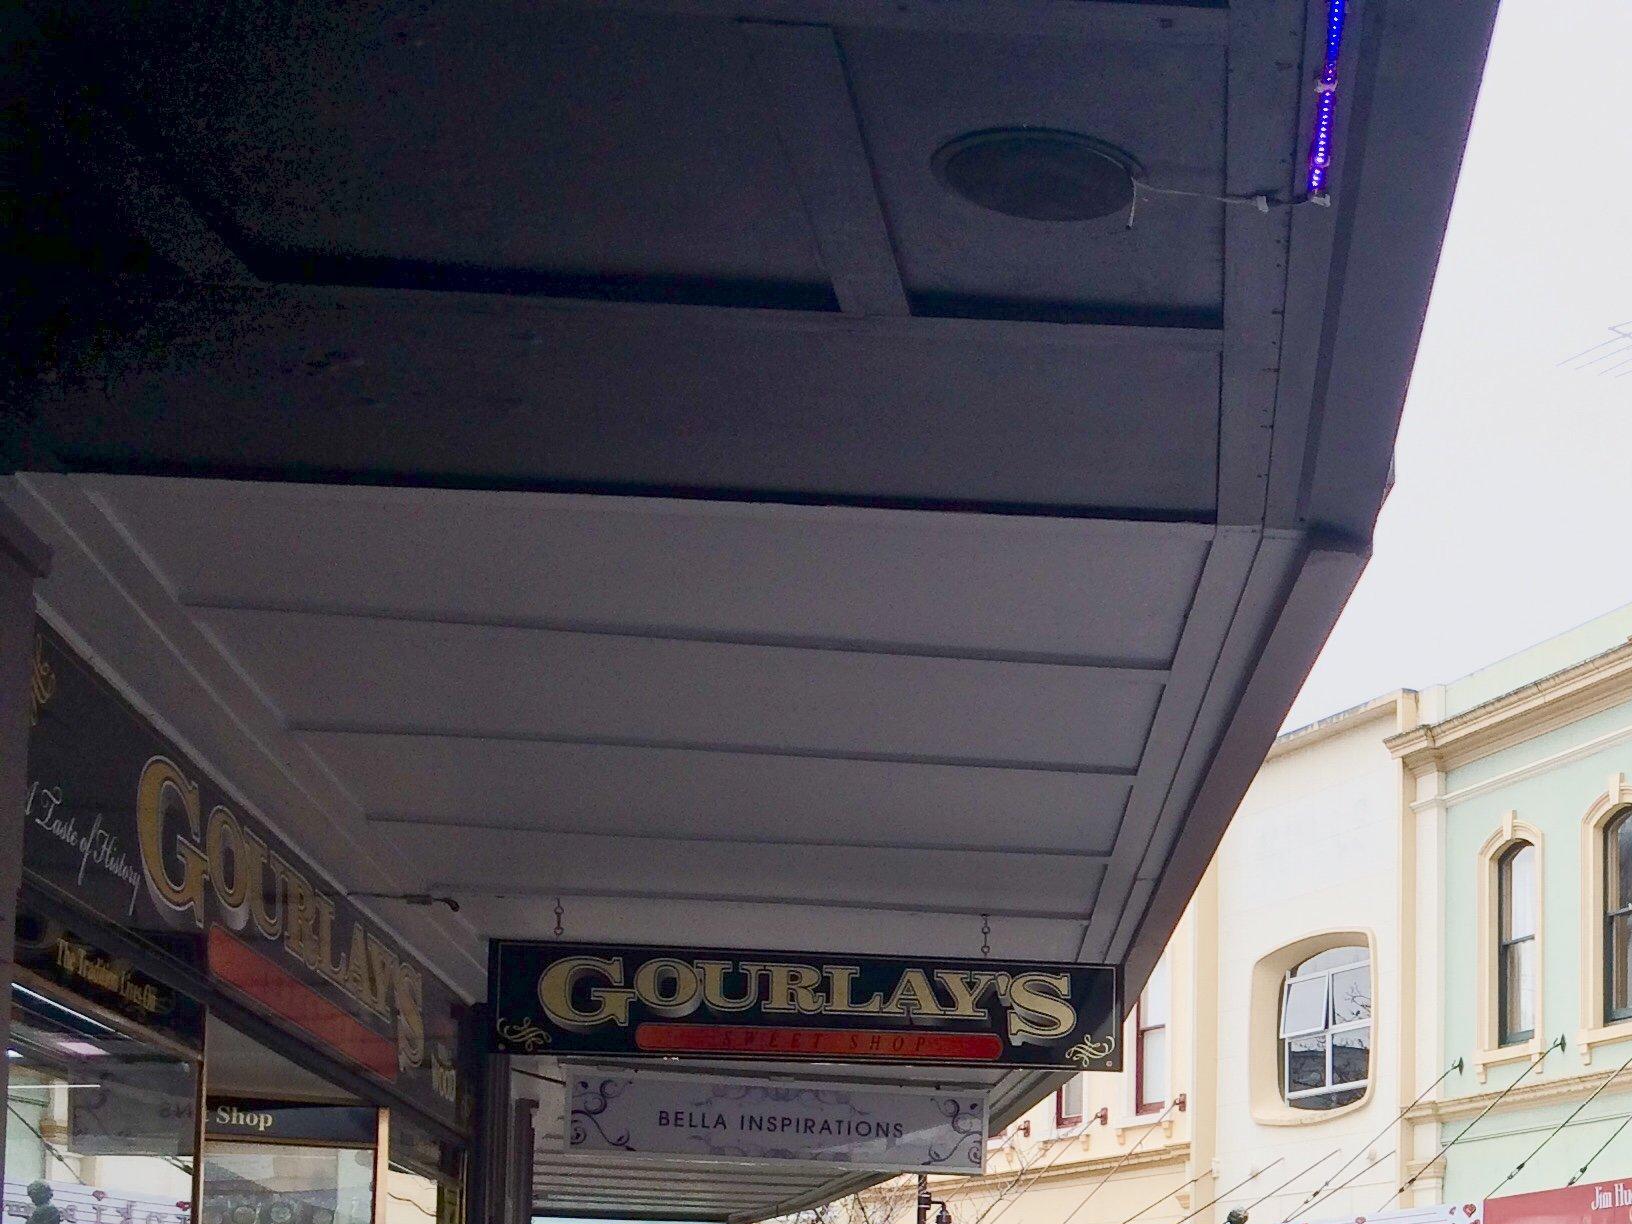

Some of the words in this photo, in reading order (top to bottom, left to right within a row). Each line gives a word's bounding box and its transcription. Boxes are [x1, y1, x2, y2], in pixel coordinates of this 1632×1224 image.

[93, 828, 141, 917] History
[537, 955, 1078, 1047] GOURLAY'S
[722, 1032, 824, 1049] SWEET
[849, 1035, 927, 1051] SHOP
[216, 1105, 273, 1131] Shop
[657, 1110, 728, 1131] BELLA
[739, 1113, 904, 1139] INSPIRATIONS
[1590, 1186, 1613, 1210] Jim
